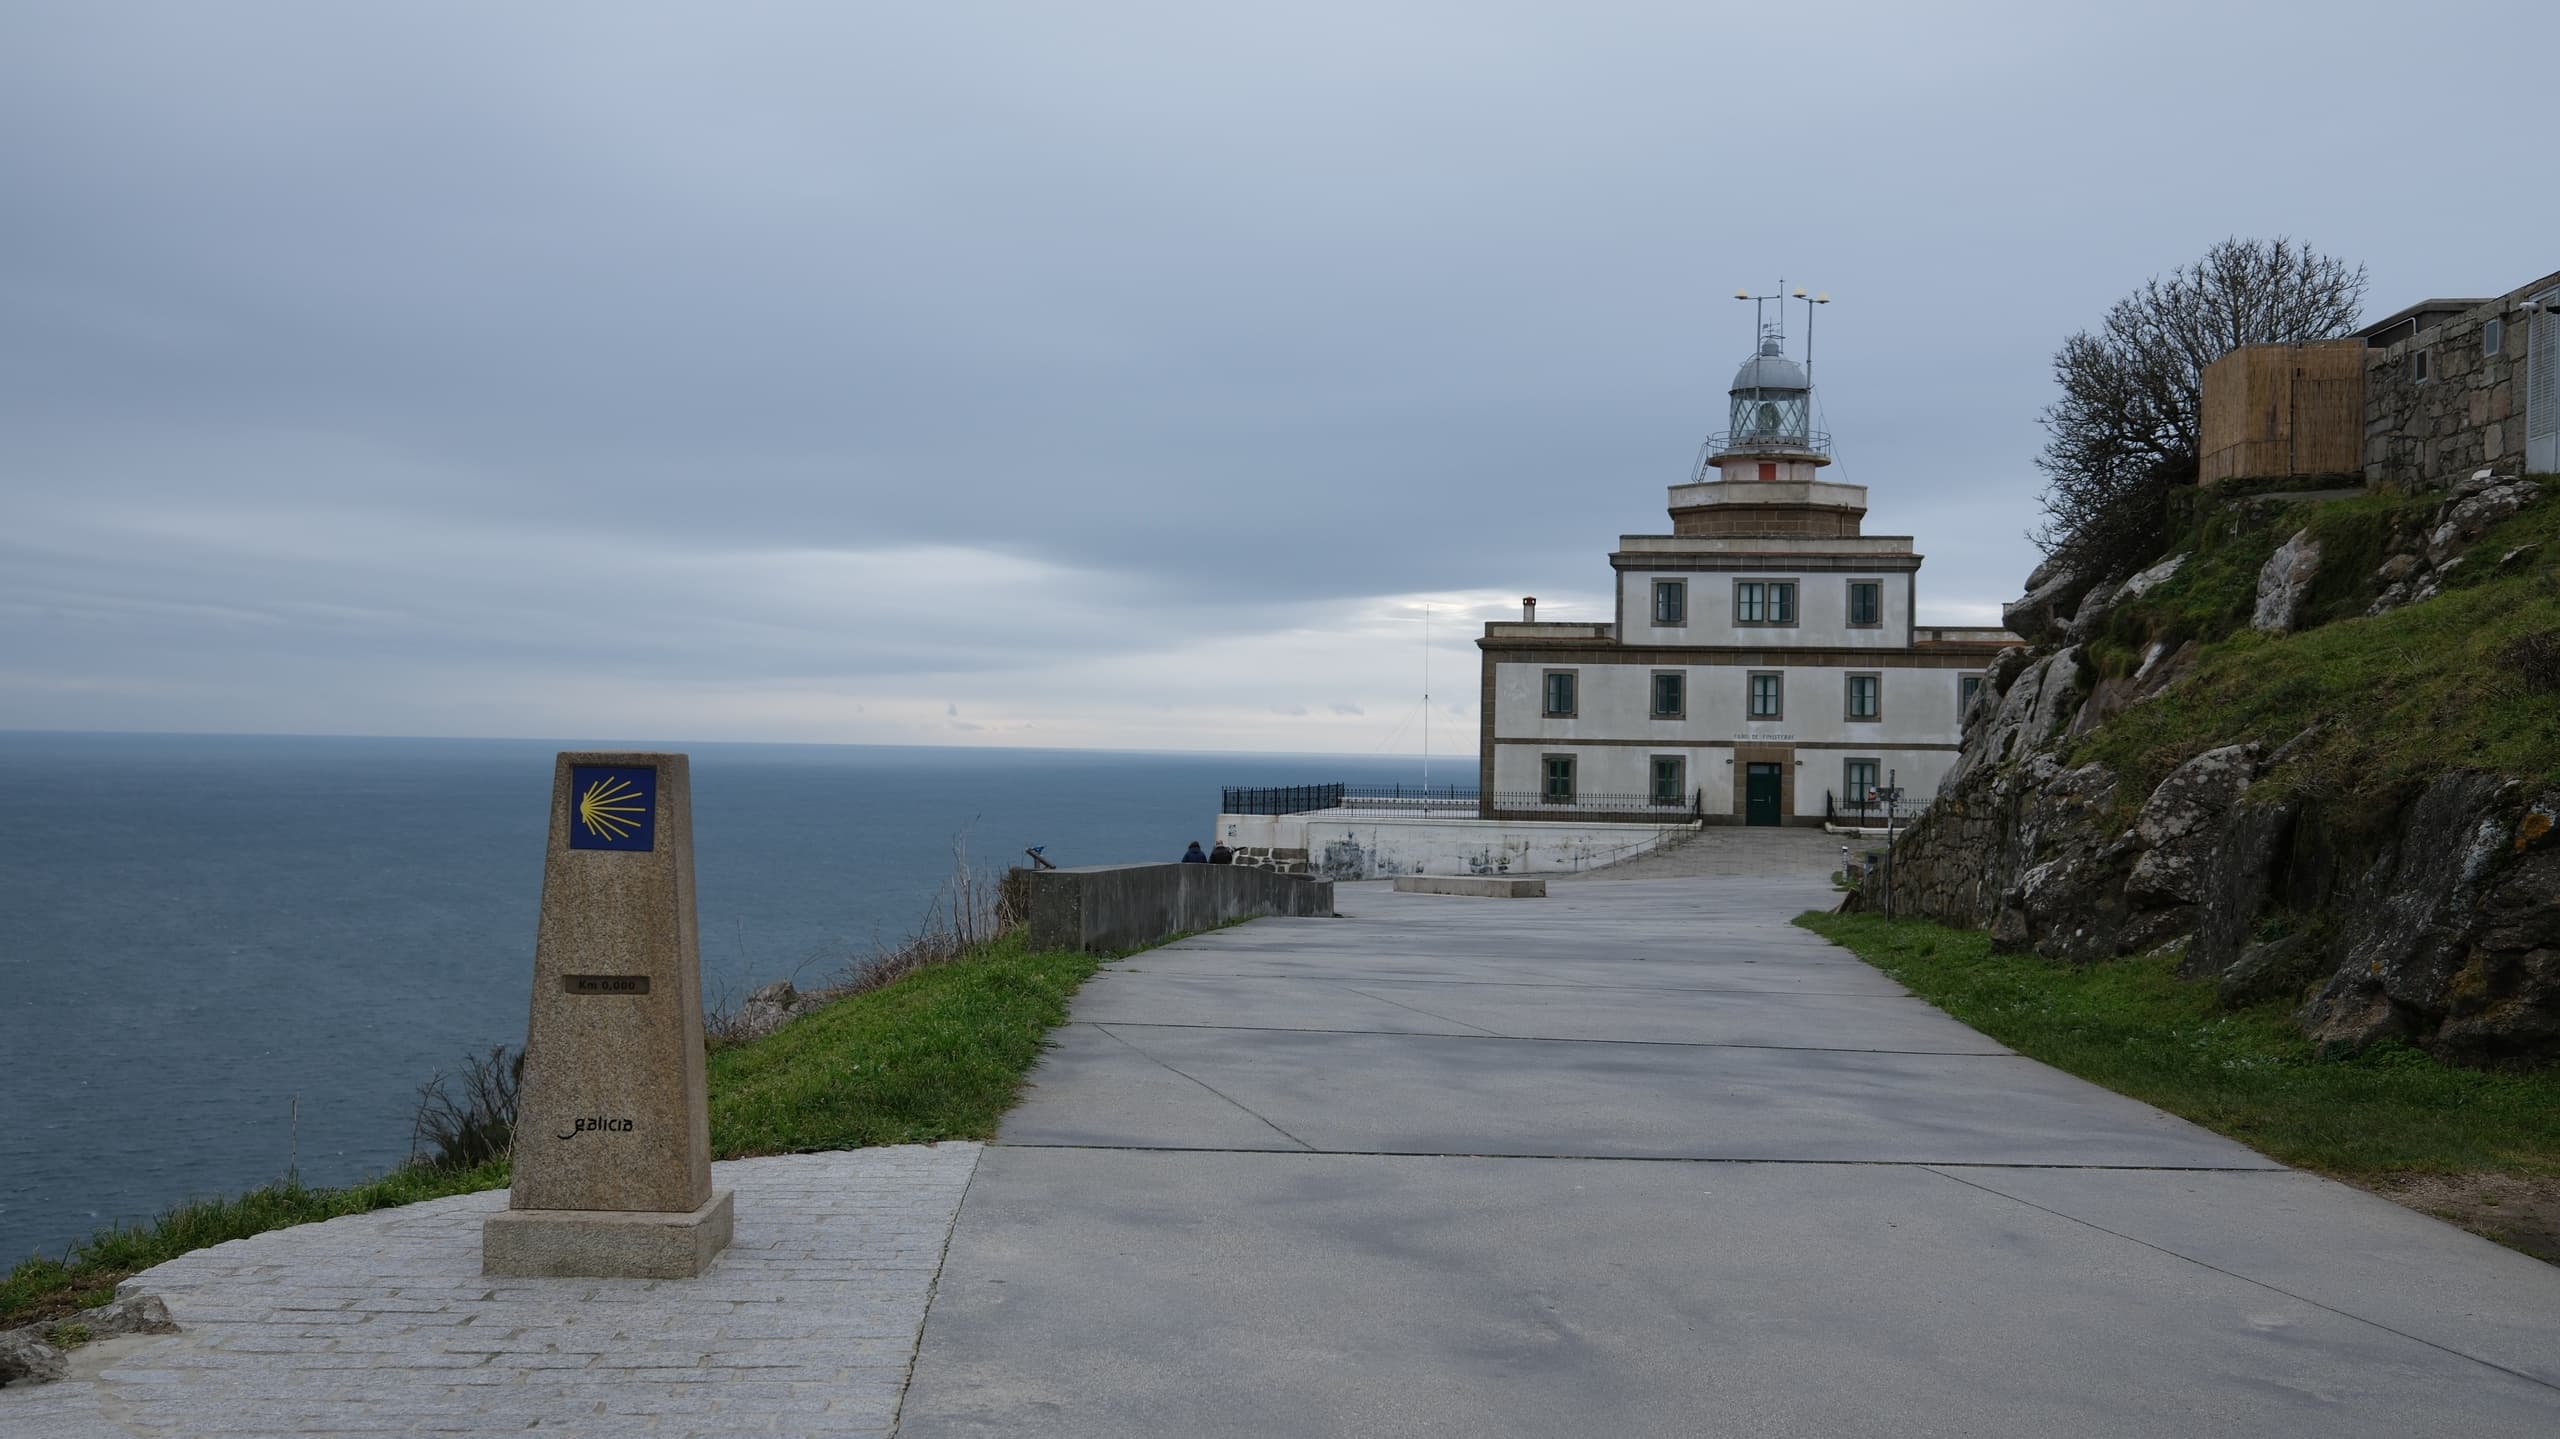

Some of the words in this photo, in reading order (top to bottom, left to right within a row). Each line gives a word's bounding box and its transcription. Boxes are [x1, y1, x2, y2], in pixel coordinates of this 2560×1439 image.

[578, 980, 597, 990] Km
[601, 980, 636, 991] 0,000
[557, 1116, 633, 1140] galicia
